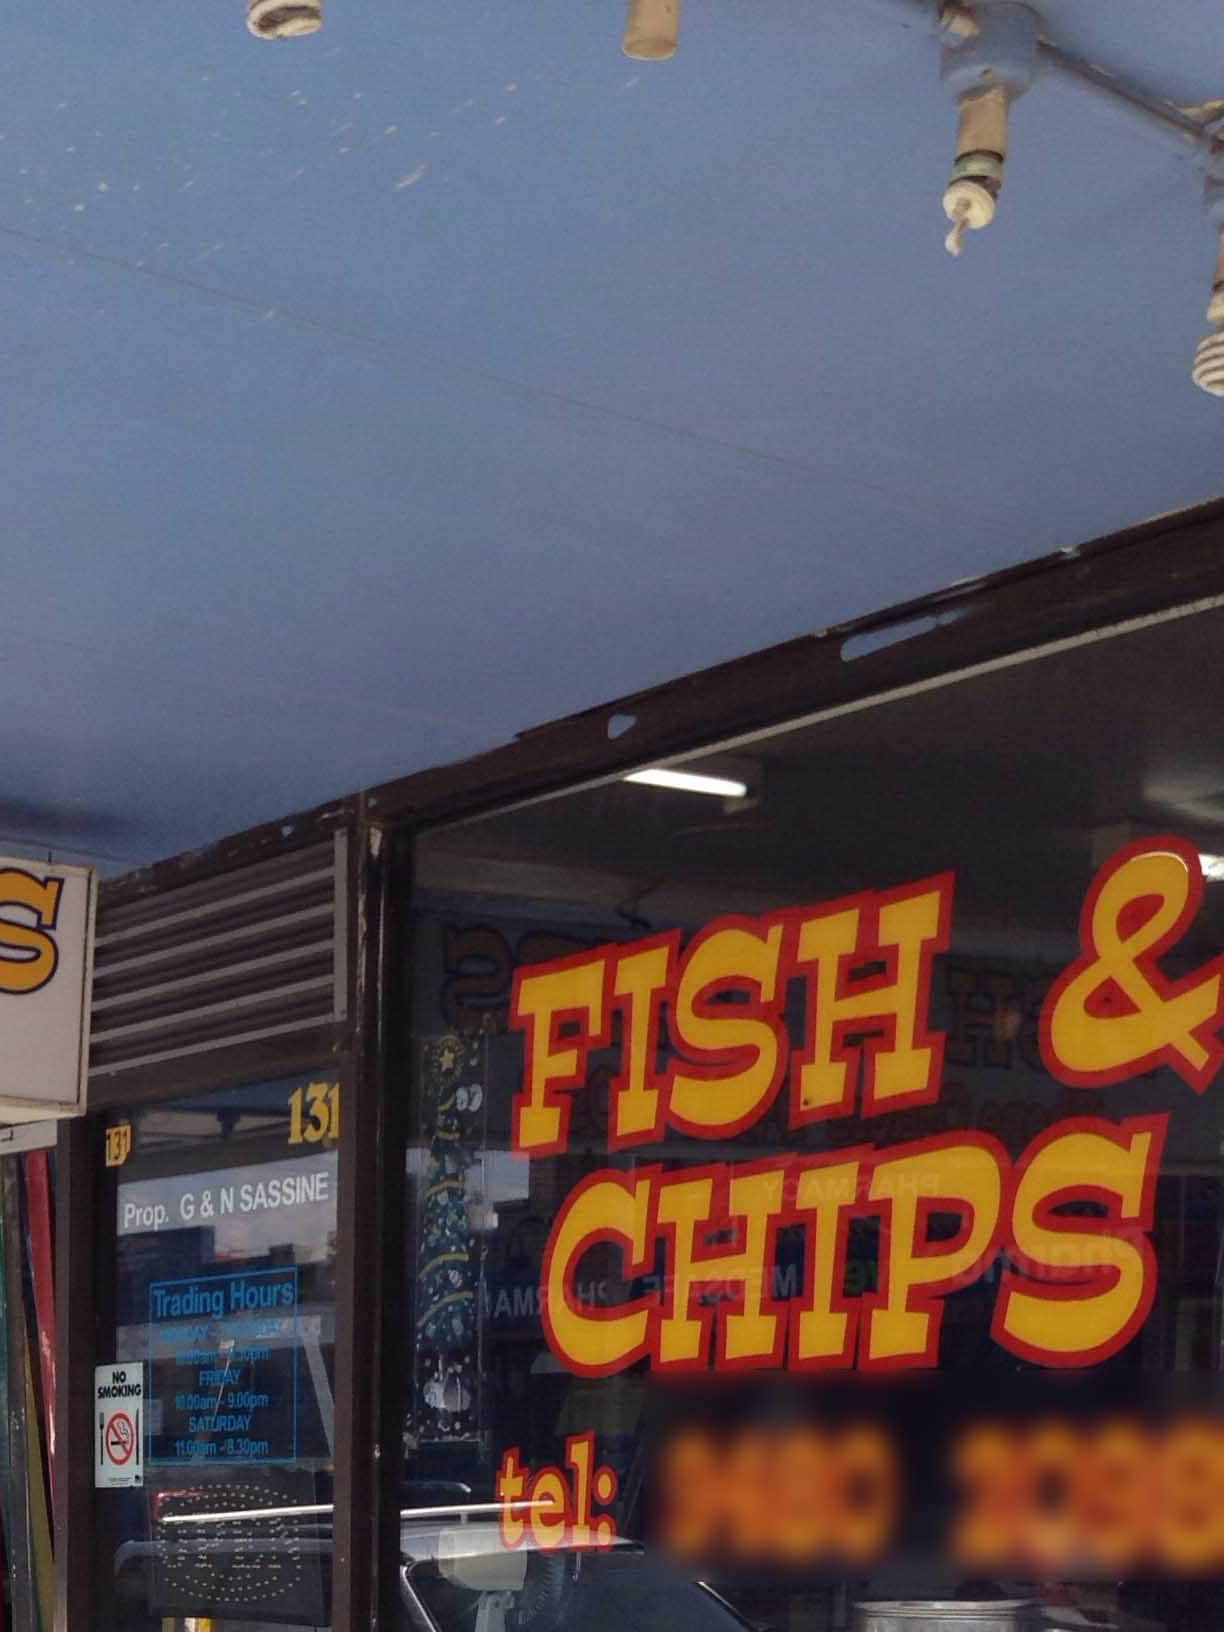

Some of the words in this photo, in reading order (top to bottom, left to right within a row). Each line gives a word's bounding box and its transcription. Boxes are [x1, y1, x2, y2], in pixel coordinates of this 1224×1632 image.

[510, 871, 956, 1160] FISH
[1038, 836, 1224, 1093] &
[288, 1082, 341, 1145] 131
[124, 1203, 169, 1232] Prop.
[180, 1193, 194, 1221] G
[200, 1190, 214, 1218] &
[220, 1187, 233, 1214] N
[240, 1172, 329, 1212] SASSINE
[541, 1112, 1169, 1378] CHIPS
[152, 1286, 225, 1319] Trading
[230, 1279, 295, 1310] Hours
[97, 1384, 141, 1399] SMOKING
[112, 1371, 126, 1384] NO
[199, 1369, 241, 1386] FRIDAY
[189, 1414, 252, 1433] SATURDAY
[496, 1430, 618, 1553] tel:
